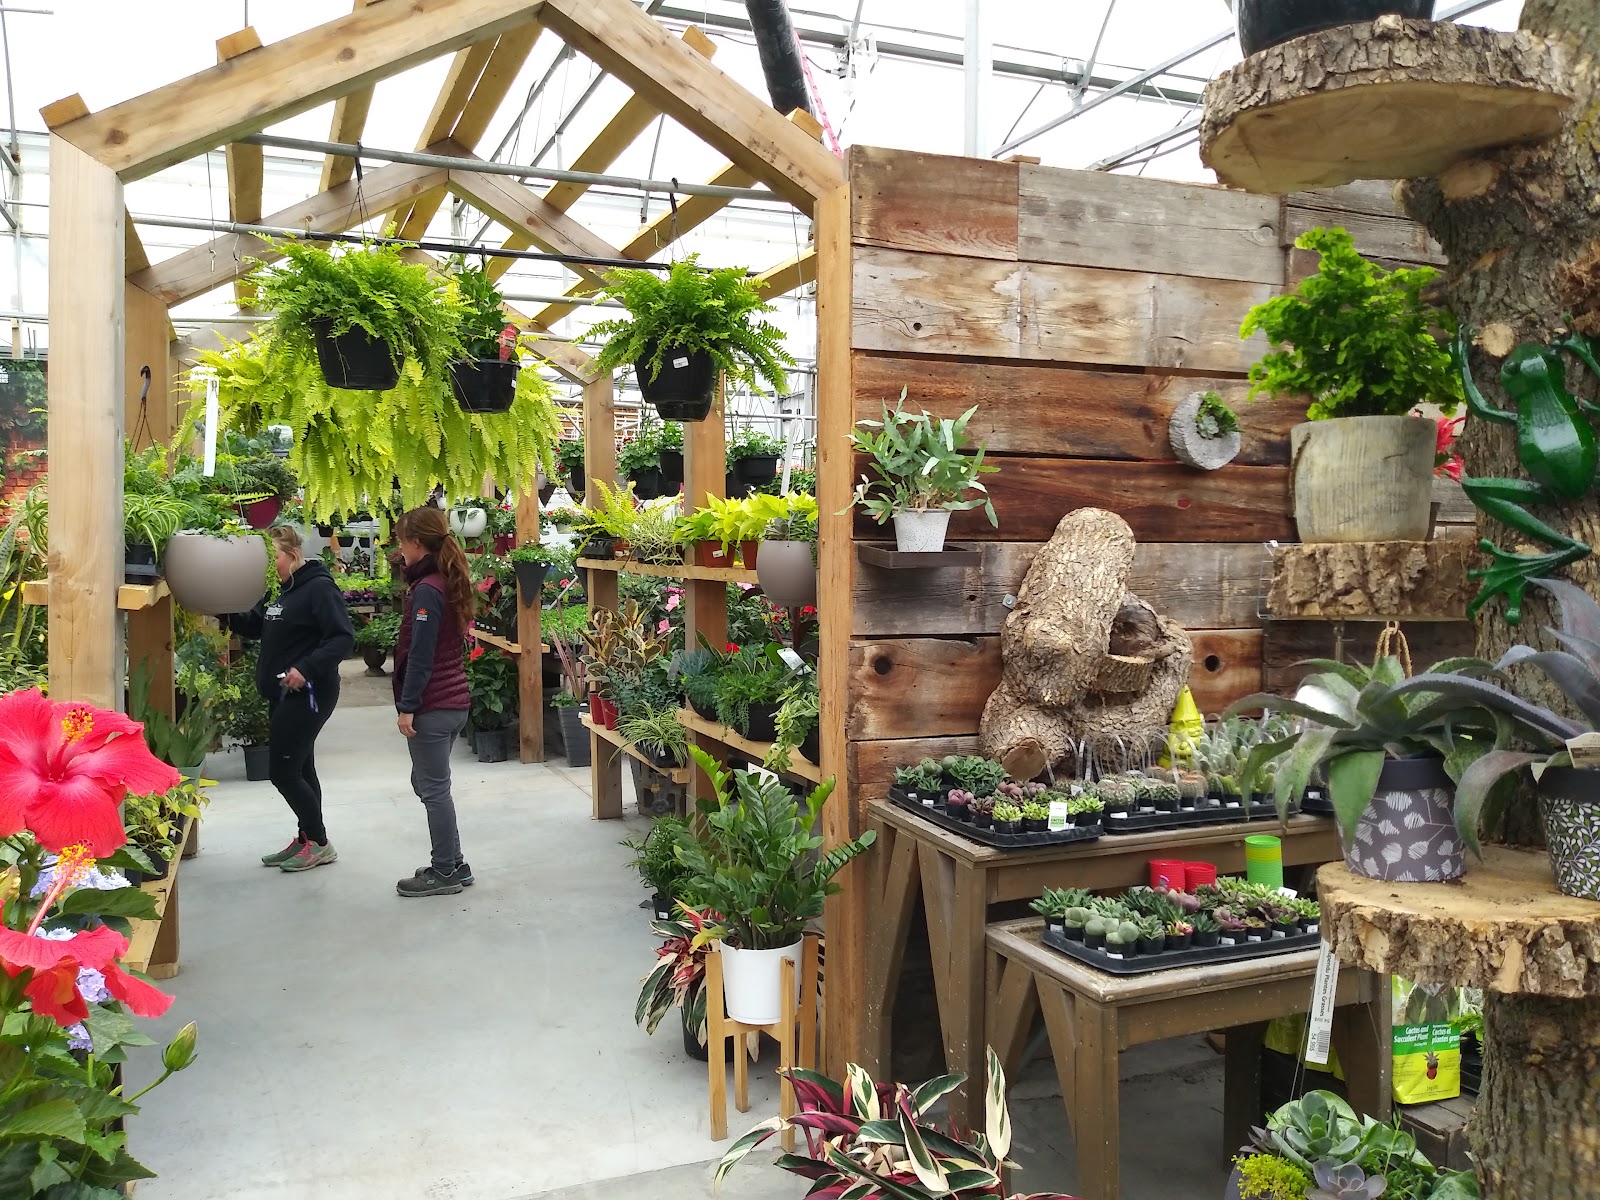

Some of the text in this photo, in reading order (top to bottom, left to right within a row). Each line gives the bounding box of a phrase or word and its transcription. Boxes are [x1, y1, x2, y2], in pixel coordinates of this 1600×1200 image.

[1322, 974, 1330, 995] Plantes
[1319, 996, 1328, 1016] Grasses
[1394, 1035, 1416, 1043] Succulent
[1432, 1036, 1448, 1045] plantes
